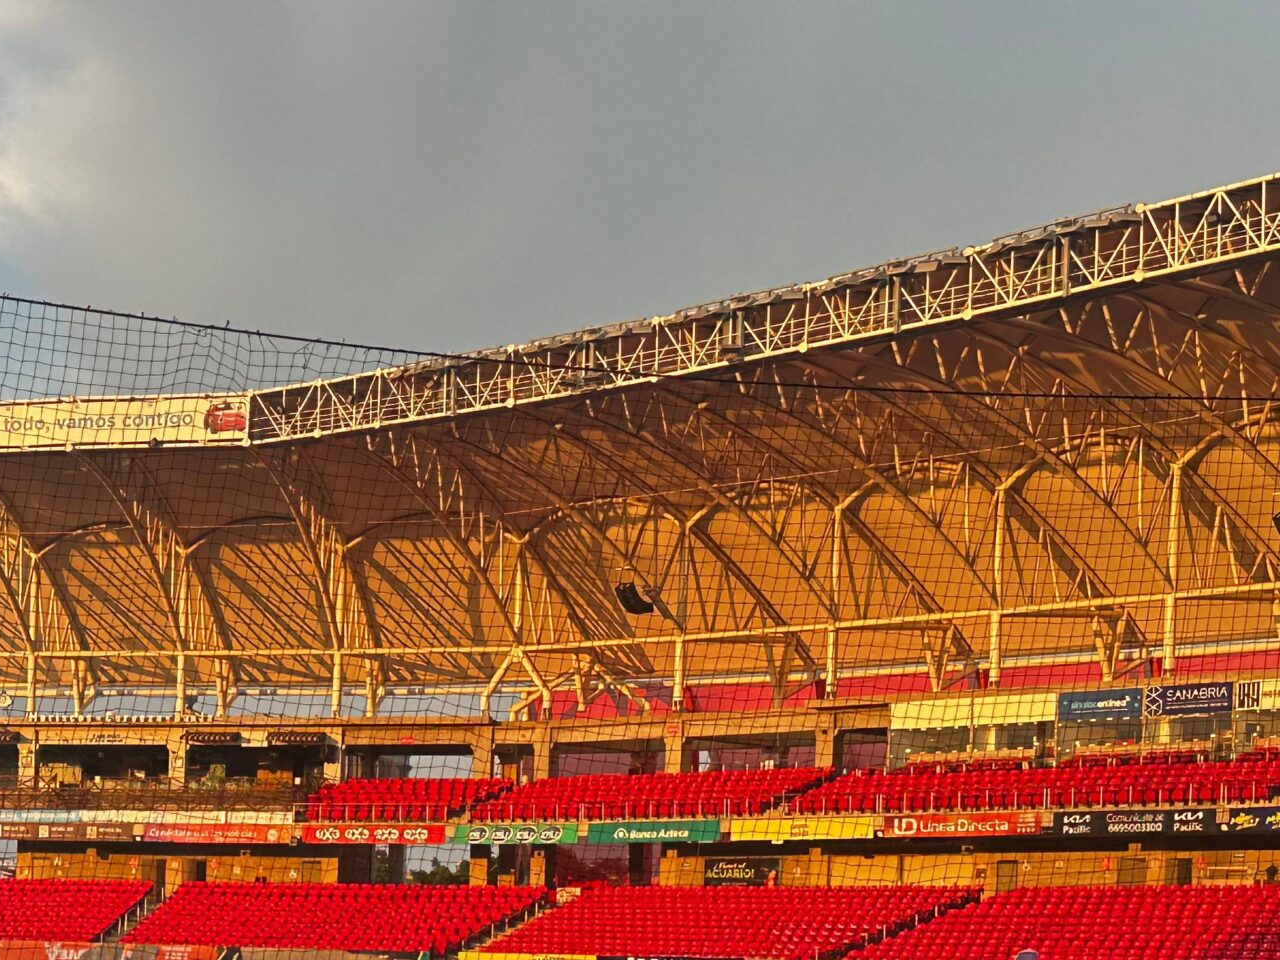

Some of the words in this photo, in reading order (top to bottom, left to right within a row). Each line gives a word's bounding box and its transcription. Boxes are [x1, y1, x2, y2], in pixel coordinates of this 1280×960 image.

[4, 416, 51, 434] todo,
[56, 416, 117, 430] vamos
[122, 411, 194, 431] contigo
[1166, 686, 1228, 701] SANABRIA
[957, 818, 1009, 832] Directa
[629, 830, 657, 839] Banco
[658, 828, 689, 839] Azteca
